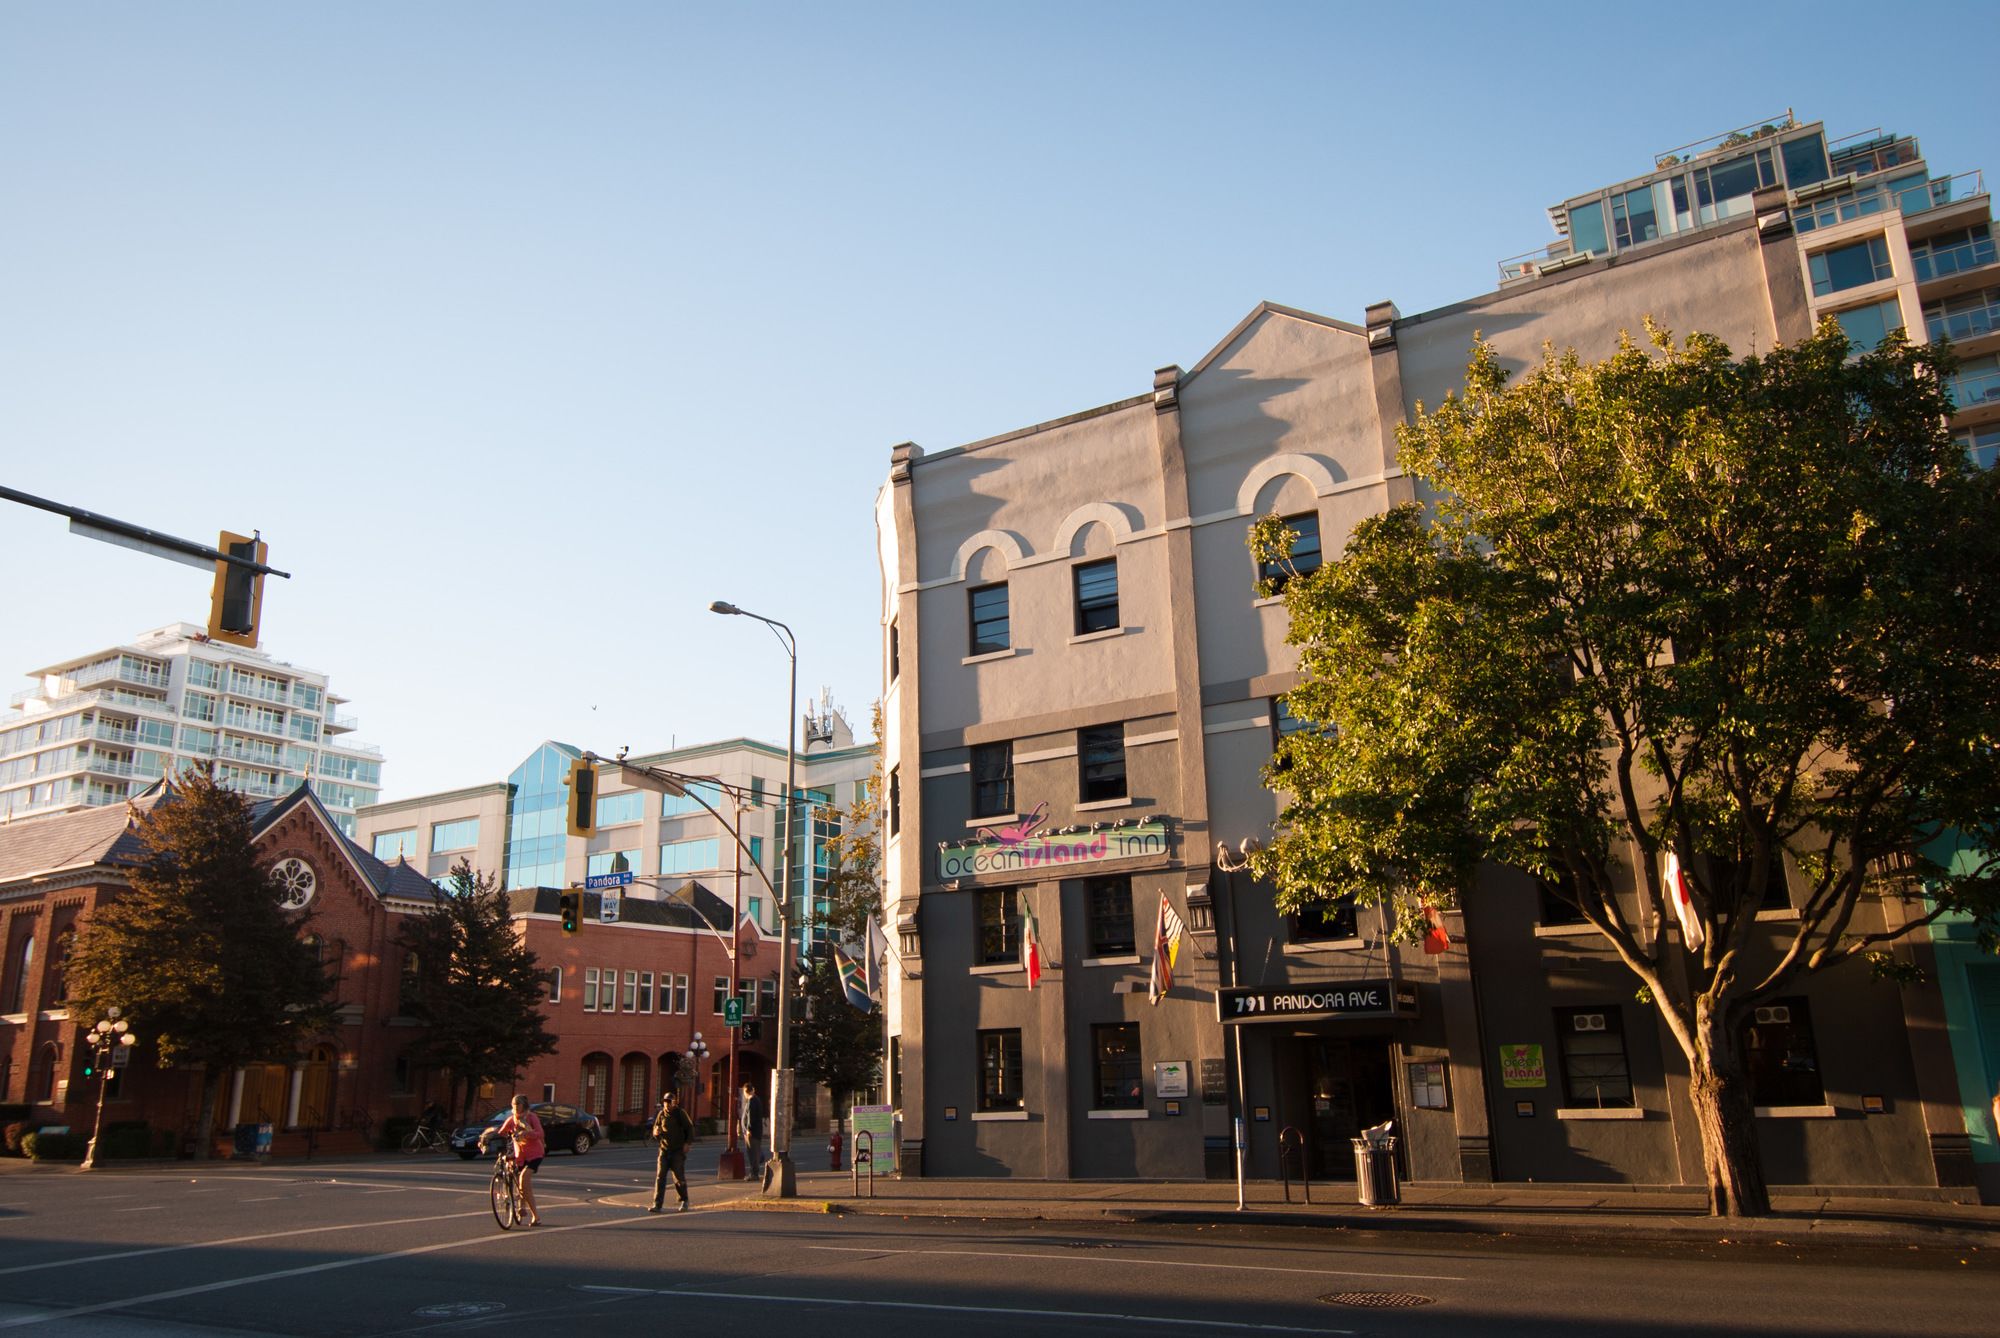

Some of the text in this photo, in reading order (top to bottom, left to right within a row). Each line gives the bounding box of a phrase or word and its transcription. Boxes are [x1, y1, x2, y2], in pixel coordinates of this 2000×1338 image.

[946, 832, 1159, 875] ocean island inn
[588, 875, 621, 888] Pandora
[604, 891, 617, 900] ONE
[603, 901, 618, 909] WAY
[1234, 995, 1266, 1013] 791
[1273, 992, 1345, 1011] PANDORA
[1349, 990, 1383, 1007] AVE.
[1503, 1058, 1542, 1068] ocean
[1504, 1067, 1543, 1078] island
